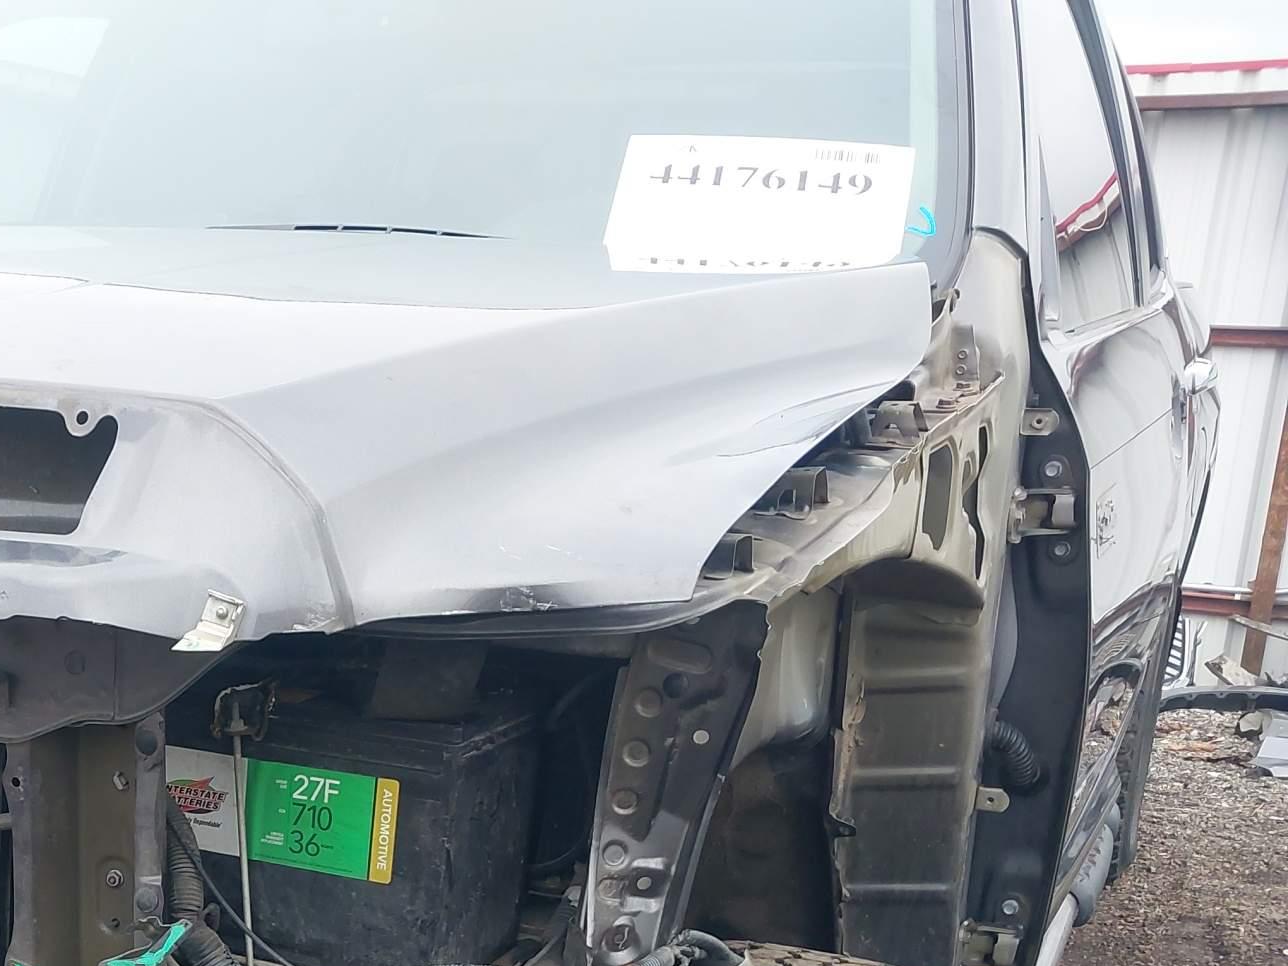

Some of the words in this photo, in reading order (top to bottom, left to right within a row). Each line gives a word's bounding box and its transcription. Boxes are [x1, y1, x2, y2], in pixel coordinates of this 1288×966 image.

[649, 163, 873, 195] 44176149
[166, 784, 226, 802] NTERSTATE
[176, 795, 220, 811] TTERIES
[292, 774, 340, 804] 27F
[292, 802, 333, 831] 710
[376, 788, 394, 871] AUTOMOTIVE
[288, 830, 320, 857] 36
